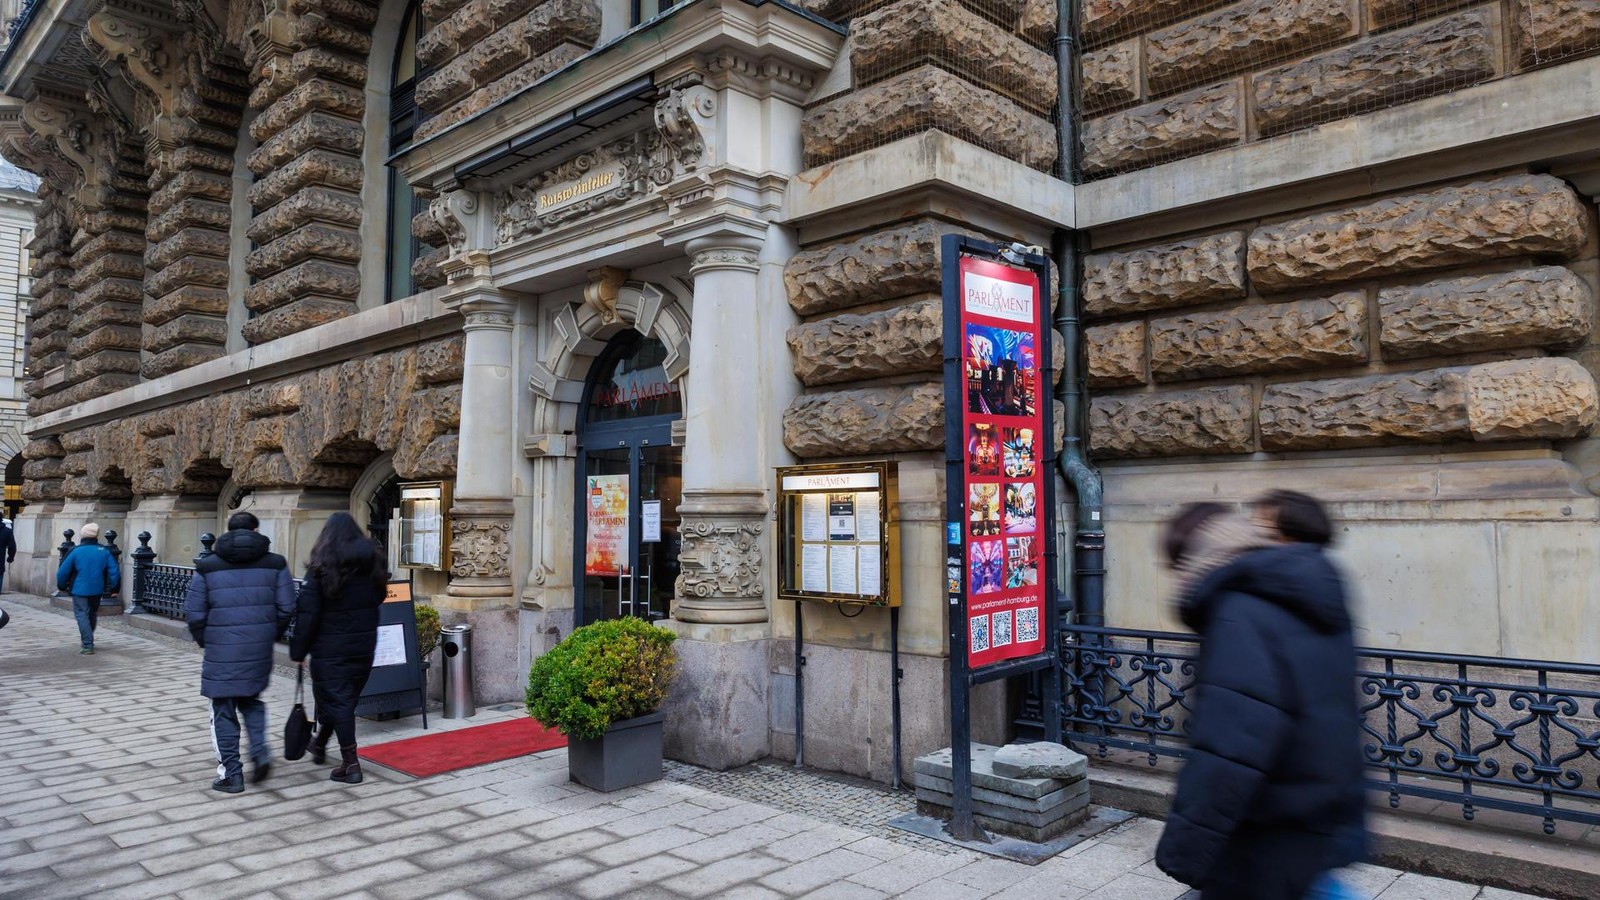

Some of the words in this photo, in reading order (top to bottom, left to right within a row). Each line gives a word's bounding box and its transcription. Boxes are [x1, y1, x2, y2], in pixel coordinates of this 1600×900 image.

[968, 288, 1030, 313] PARLAMENT
[807, 476, 850, 487] PARLAMENT
[971, 595, 1037, 610] www.parlament-hamburg.de
